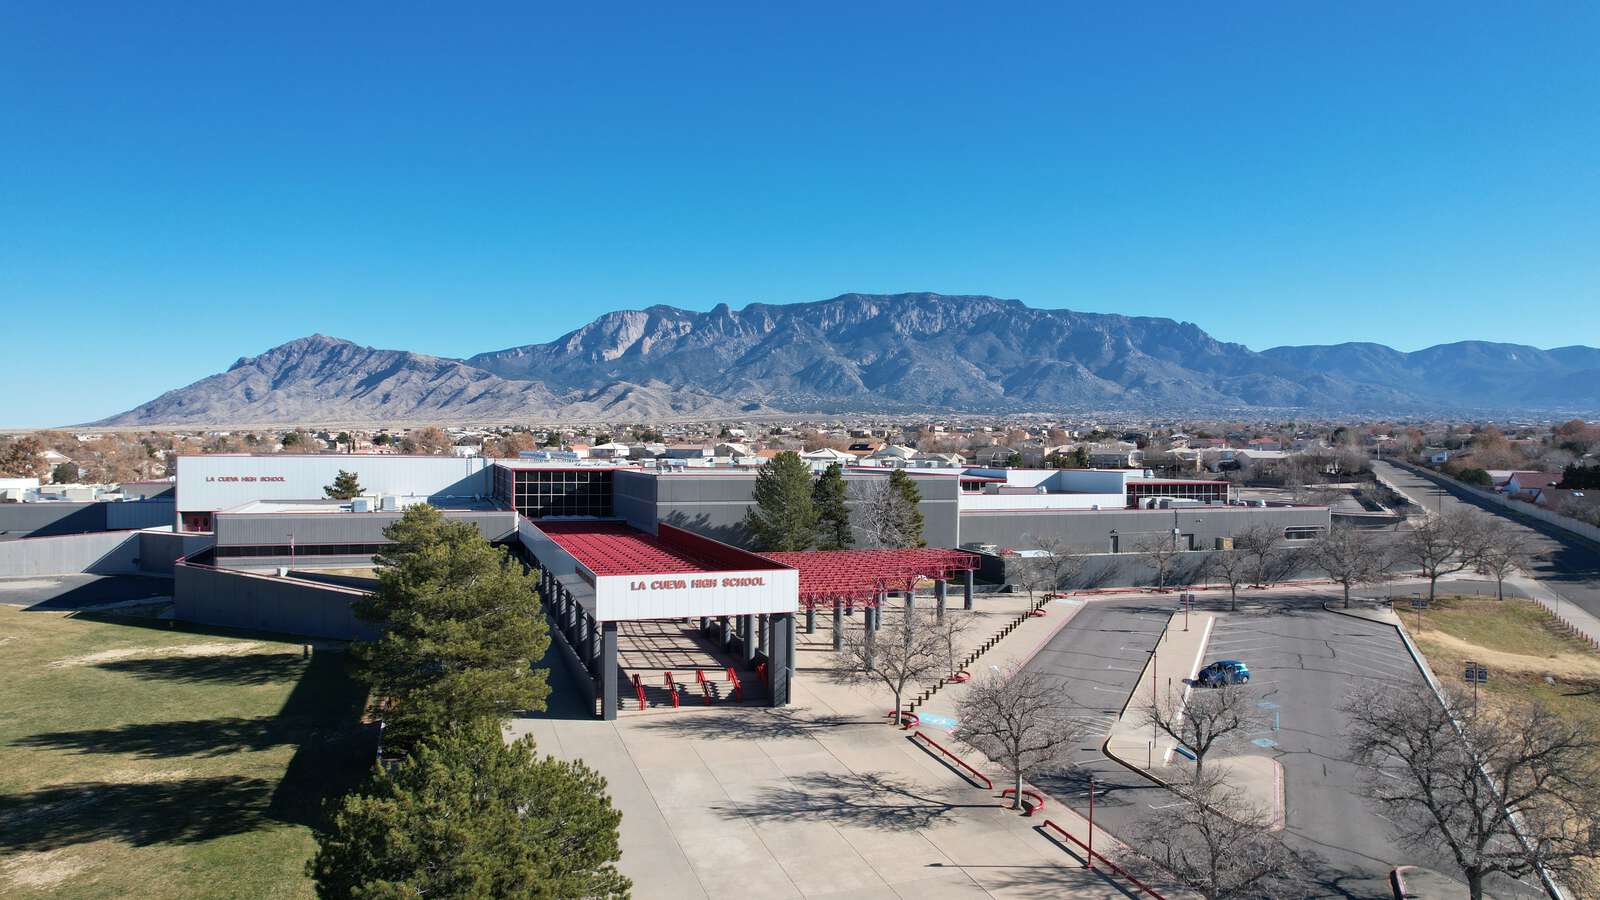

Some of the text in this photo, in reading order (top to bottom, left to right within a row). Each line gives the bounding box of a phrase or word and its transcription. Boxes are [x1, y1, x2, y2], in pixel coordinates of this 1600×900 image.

[630, 576, 766, 591] LA CUEVA HIGH SCHOOL
